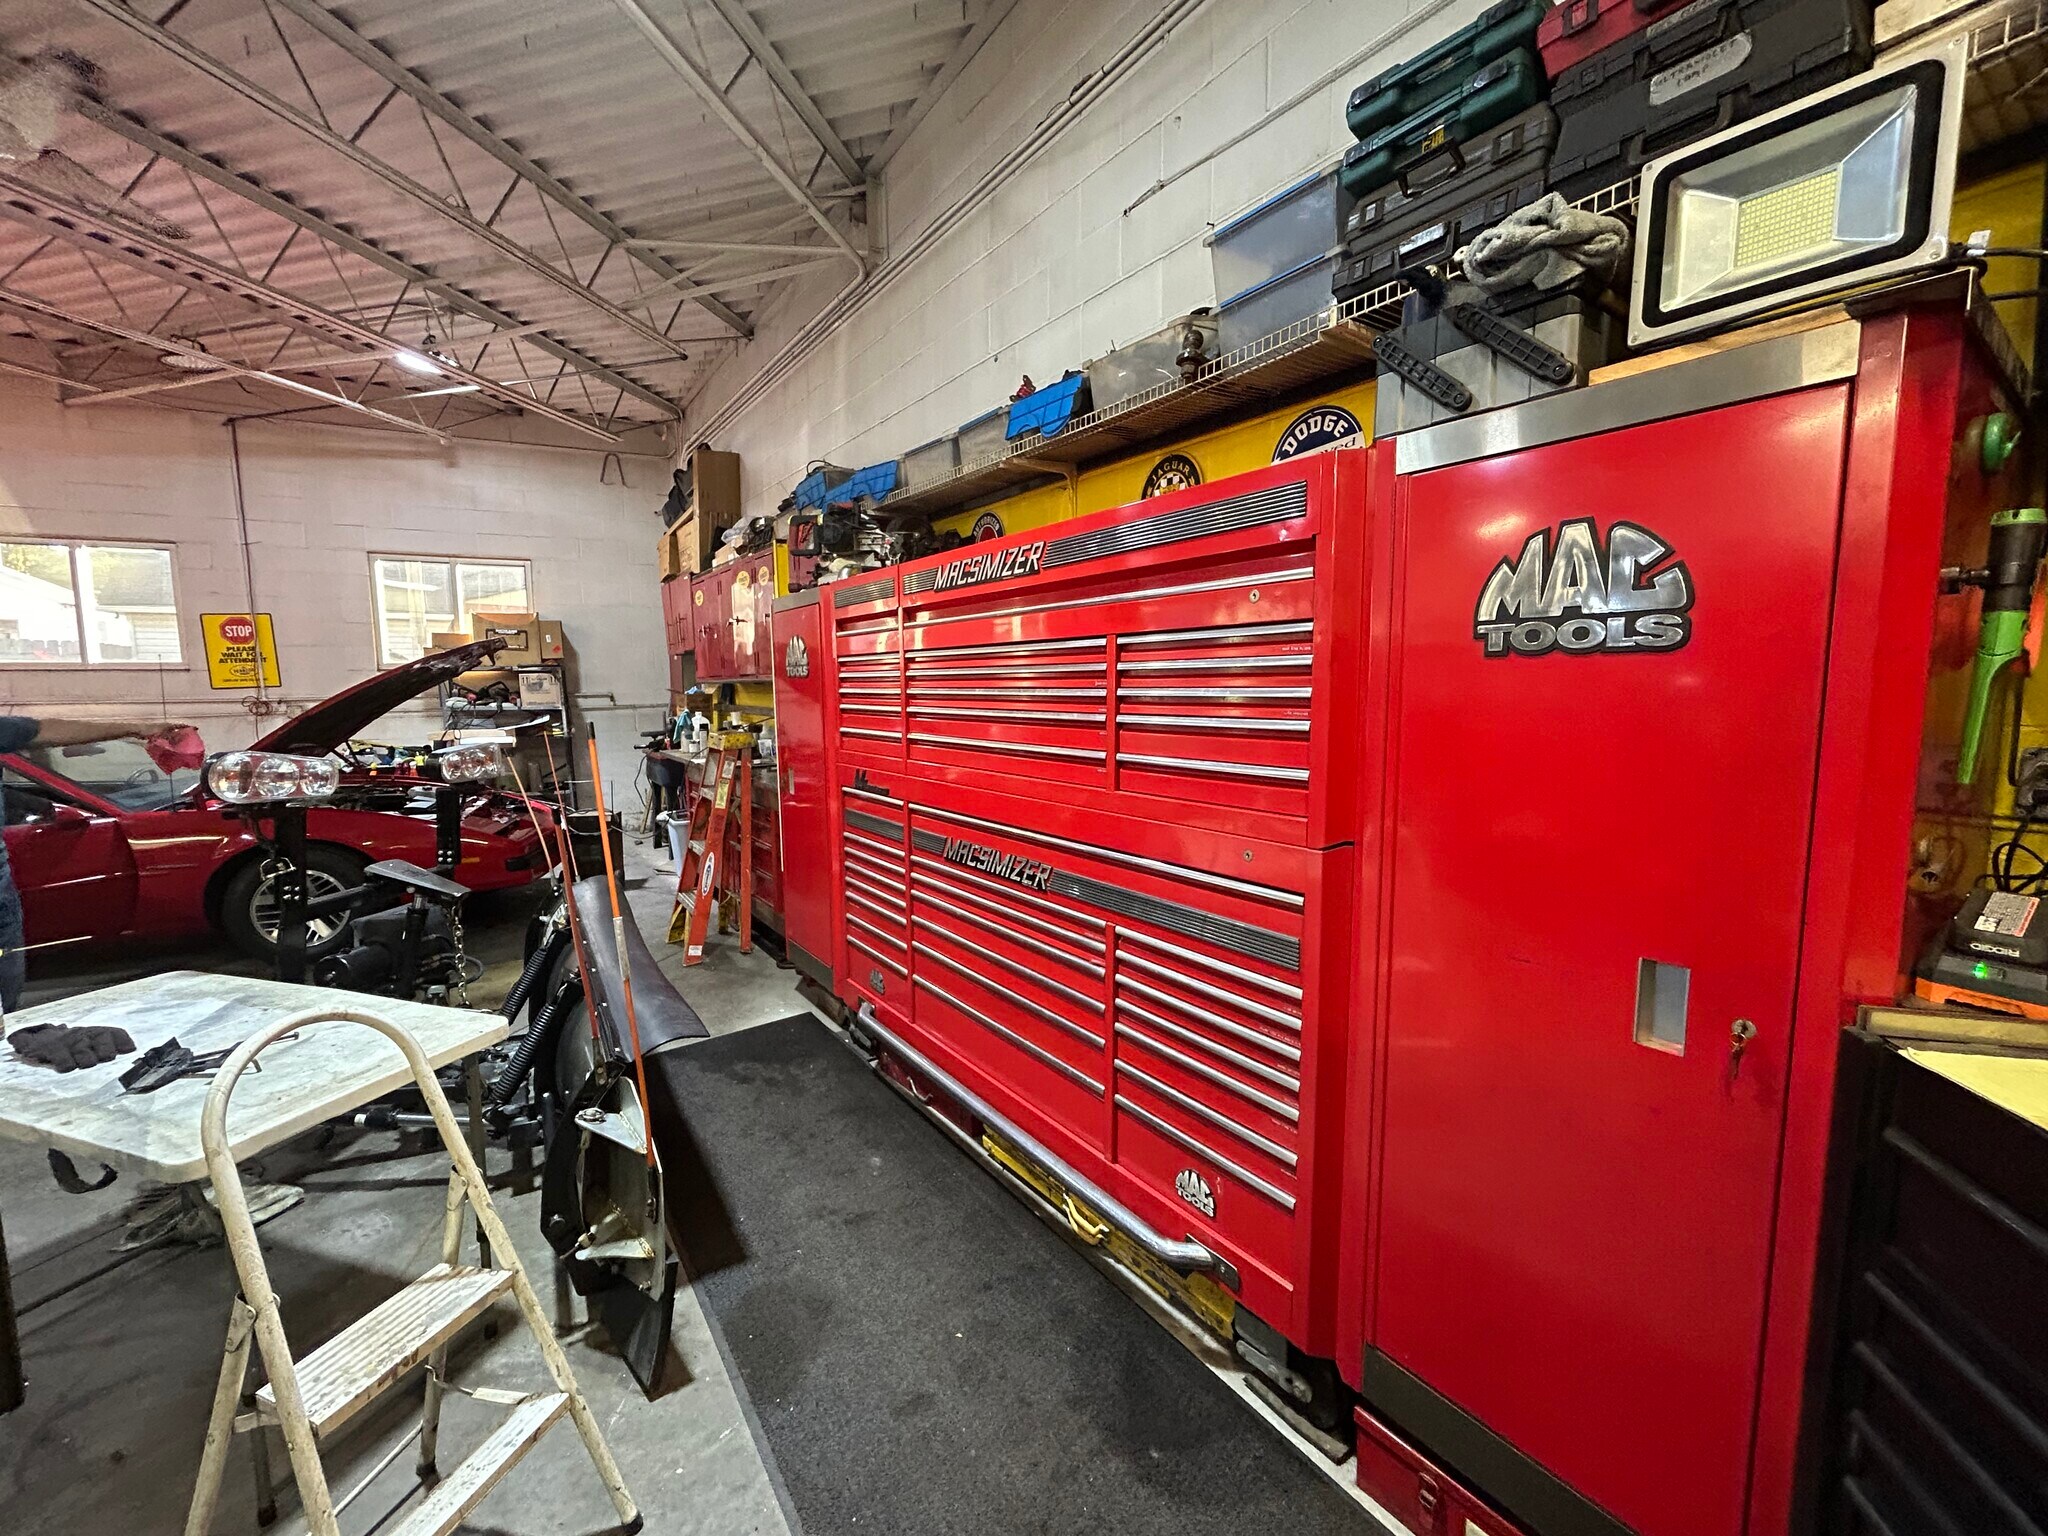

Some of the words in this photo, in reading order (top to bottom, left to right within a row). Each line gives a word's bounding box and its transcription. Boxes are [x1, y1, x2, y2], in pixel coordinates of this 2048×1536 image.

[1282, 414, 1349, 455] DODGE
[1152, 460, 1190, 484] JAGUAR
[933, 540, 1045, 590] MACSIMIZER
[1477, 521, 1688, 621] MAC
[225, 625, 252, 637] STOP
[1477, 613, 1684, 652] TOOLS
[786, 665, 808, 678] TOOLS
[943, 836, 1052, 890] MACSIMIZER
[1969, 942, 2021, 958] RIDGID
[1175, 1169, 1215, 1209] MAC
[1175, 1184, 1215, 1217] TOOLS
